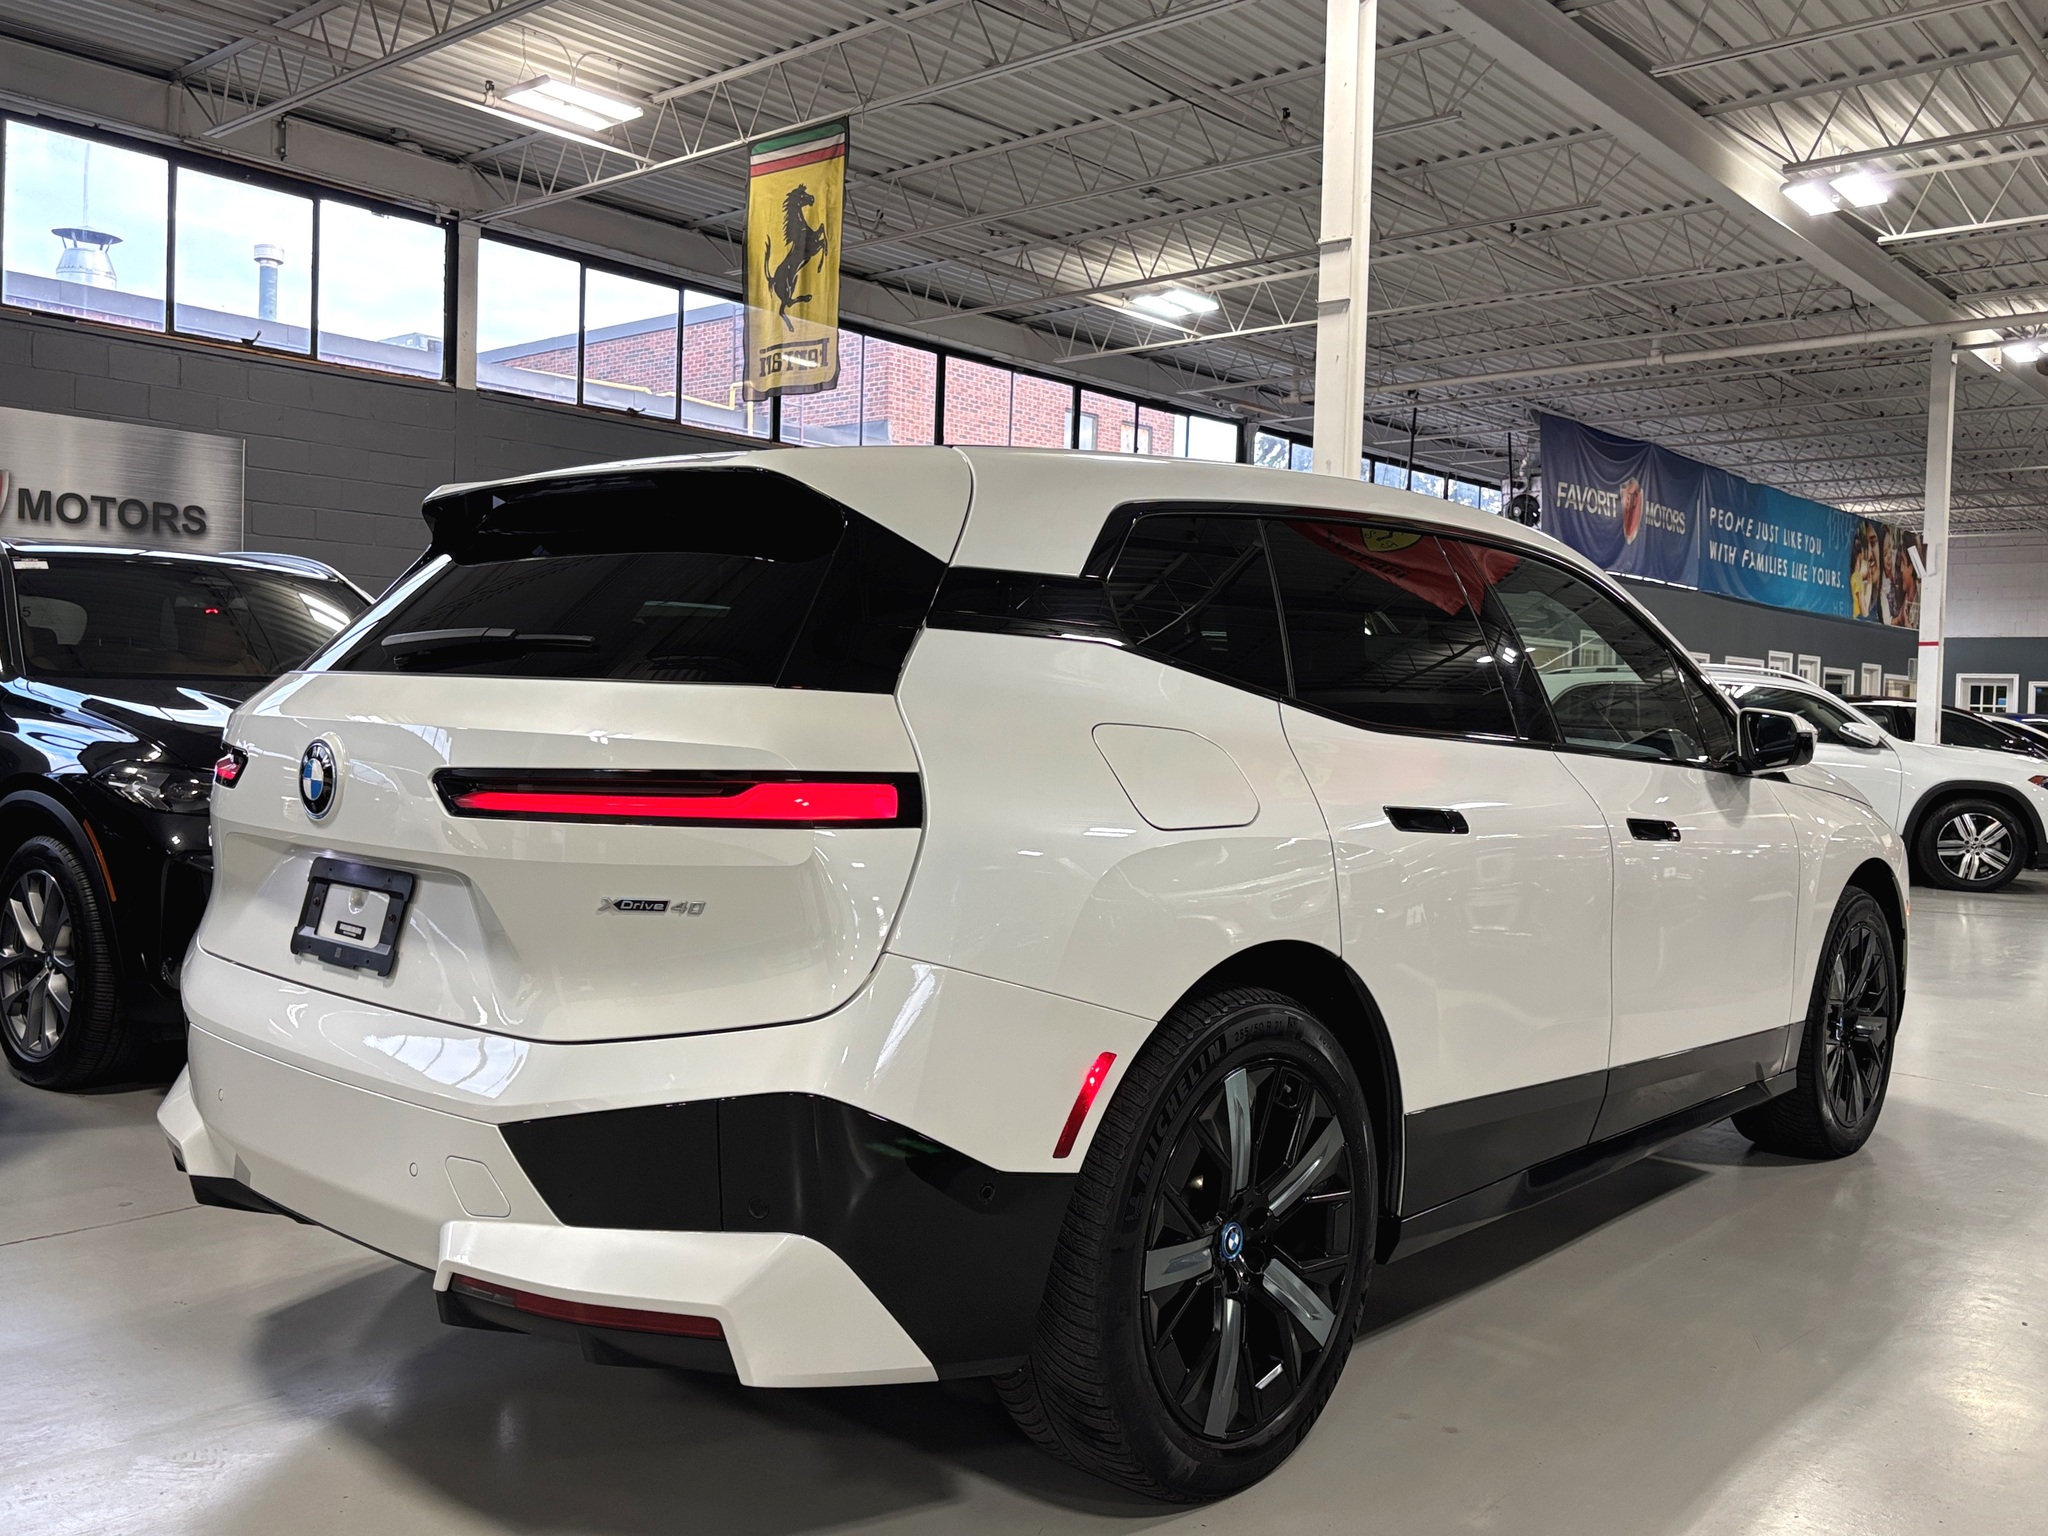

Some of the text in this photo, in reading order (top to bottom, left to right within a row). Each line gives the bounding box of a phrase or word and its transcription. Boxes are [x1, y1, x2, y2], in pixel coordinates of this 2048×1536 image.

[17, 487, 207, 535] MOTORS
[1556, 481, 1686, 535] FAVORIT MOTORS
[1756, 521, 1779, 544] JUST
[1783, 528, 1802, 550] LIKE
[1804, 535, 1825, 558] YOU,
[1709, 540, 1845, 589] WITH FAMILIES LIKE YOURS.
[670, 900, 707, 917] 40
[1136, 1037, 1226, 1187] MICHELIN
